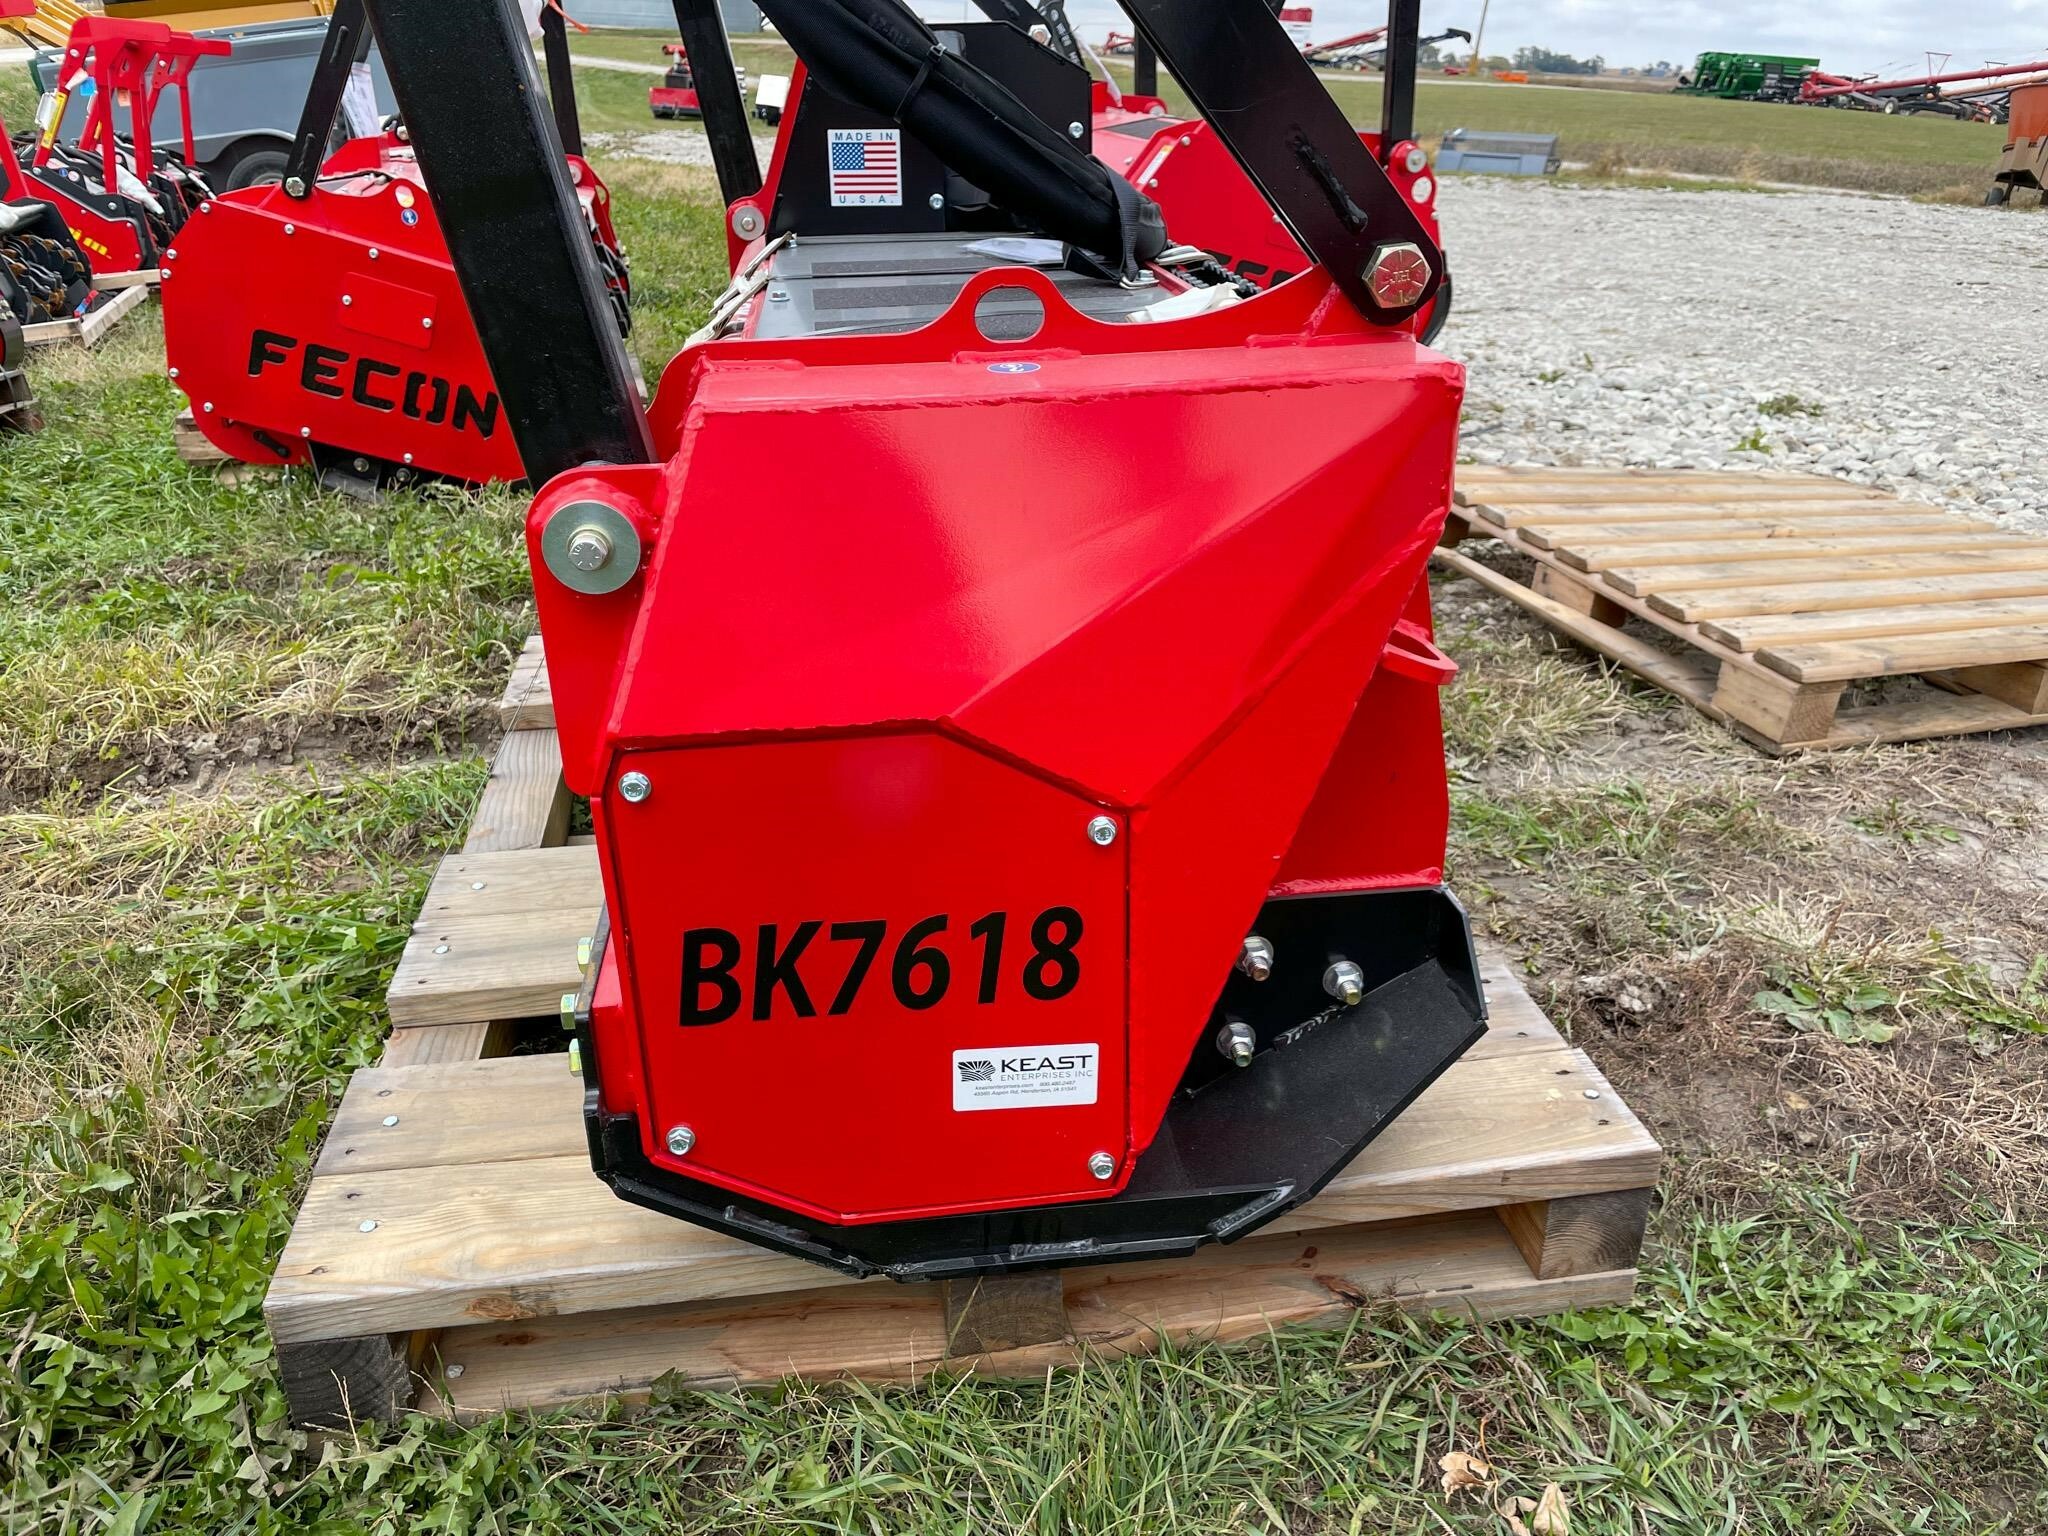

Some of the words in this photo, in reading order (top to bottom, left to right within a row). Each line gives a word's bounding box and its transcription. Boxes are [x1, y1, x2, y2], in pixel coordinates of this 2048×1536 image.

[834, 132, 873, 141] MADE
[880, 132, 893, 141] IN
[839, 194, 894, 204] U.S.A.
[247, 328, 499, 440] FECON
[679, 904, 1084, 1027] BK7618
[1001, 1054, 1093, 1073] KEAST
[1001, 1070, 1071, 1082] ENTERPRISES
[1075, 1069, 1093, 1079] INC
